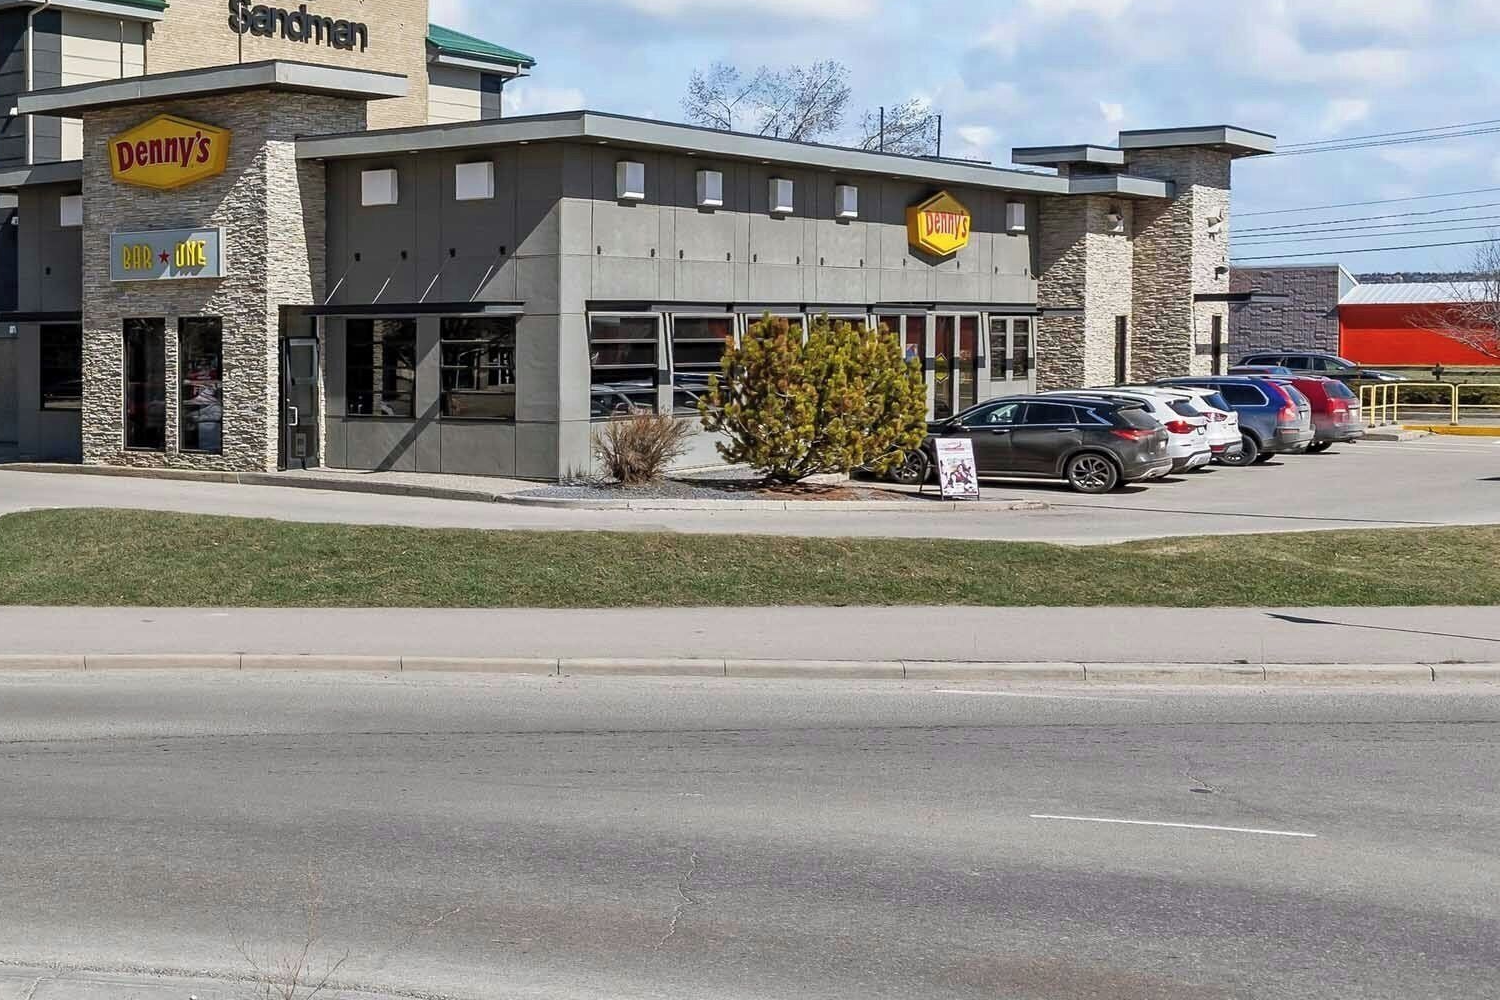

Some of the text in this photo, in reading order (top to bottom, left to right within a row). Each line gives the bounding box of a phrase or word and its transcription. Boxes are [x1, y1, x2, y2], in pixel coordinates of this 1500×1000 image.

[116, 130, 212, 172] Denny's
[925, 210, 968, 240] Denny's
[123, 239, 207, 270] BAR ONE
